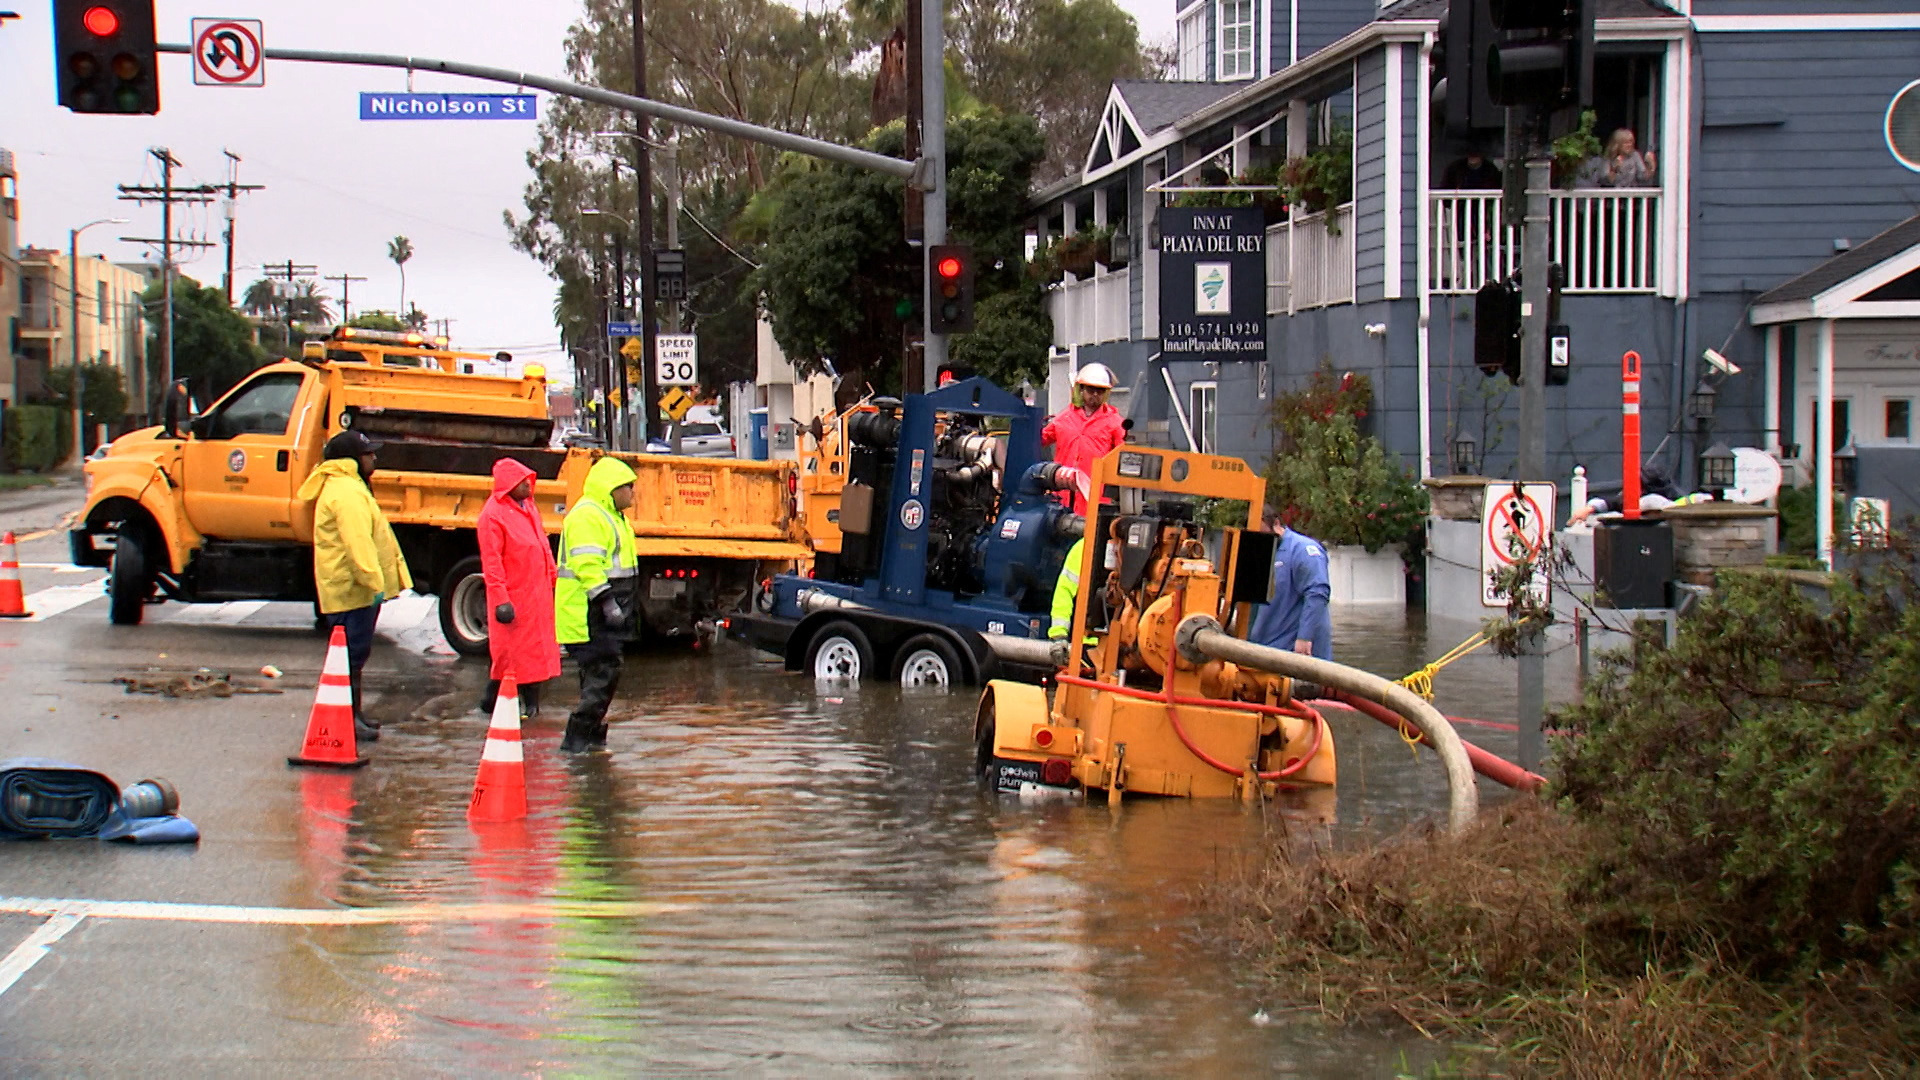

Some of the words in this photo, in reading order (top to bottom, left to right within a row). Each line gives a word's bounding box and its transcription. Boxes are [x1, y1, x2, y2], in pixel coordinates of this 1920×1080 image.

[371, 97, 491, 114] Nicholson
[501, 97, 527, 113] St
[1193, 215, 1215, 230] INN
[1218, 215, 1233, 230] AT
[1163, 235, 1204, 252] PLAYA
[1207, 235, 1234, 252] DEL
[1237, 235, 1263, 252] REY
[1169, 323, 1259, 336] 310.574.1920
[659, 339, 694, 348] SPEED
[1163, 337, 1264, 353] InnatPlayadelRey.com
[661, 362, 693, 380] 30
[318, 727, 328, 736] LA
[1000, 766, 1038, 780] godwin
